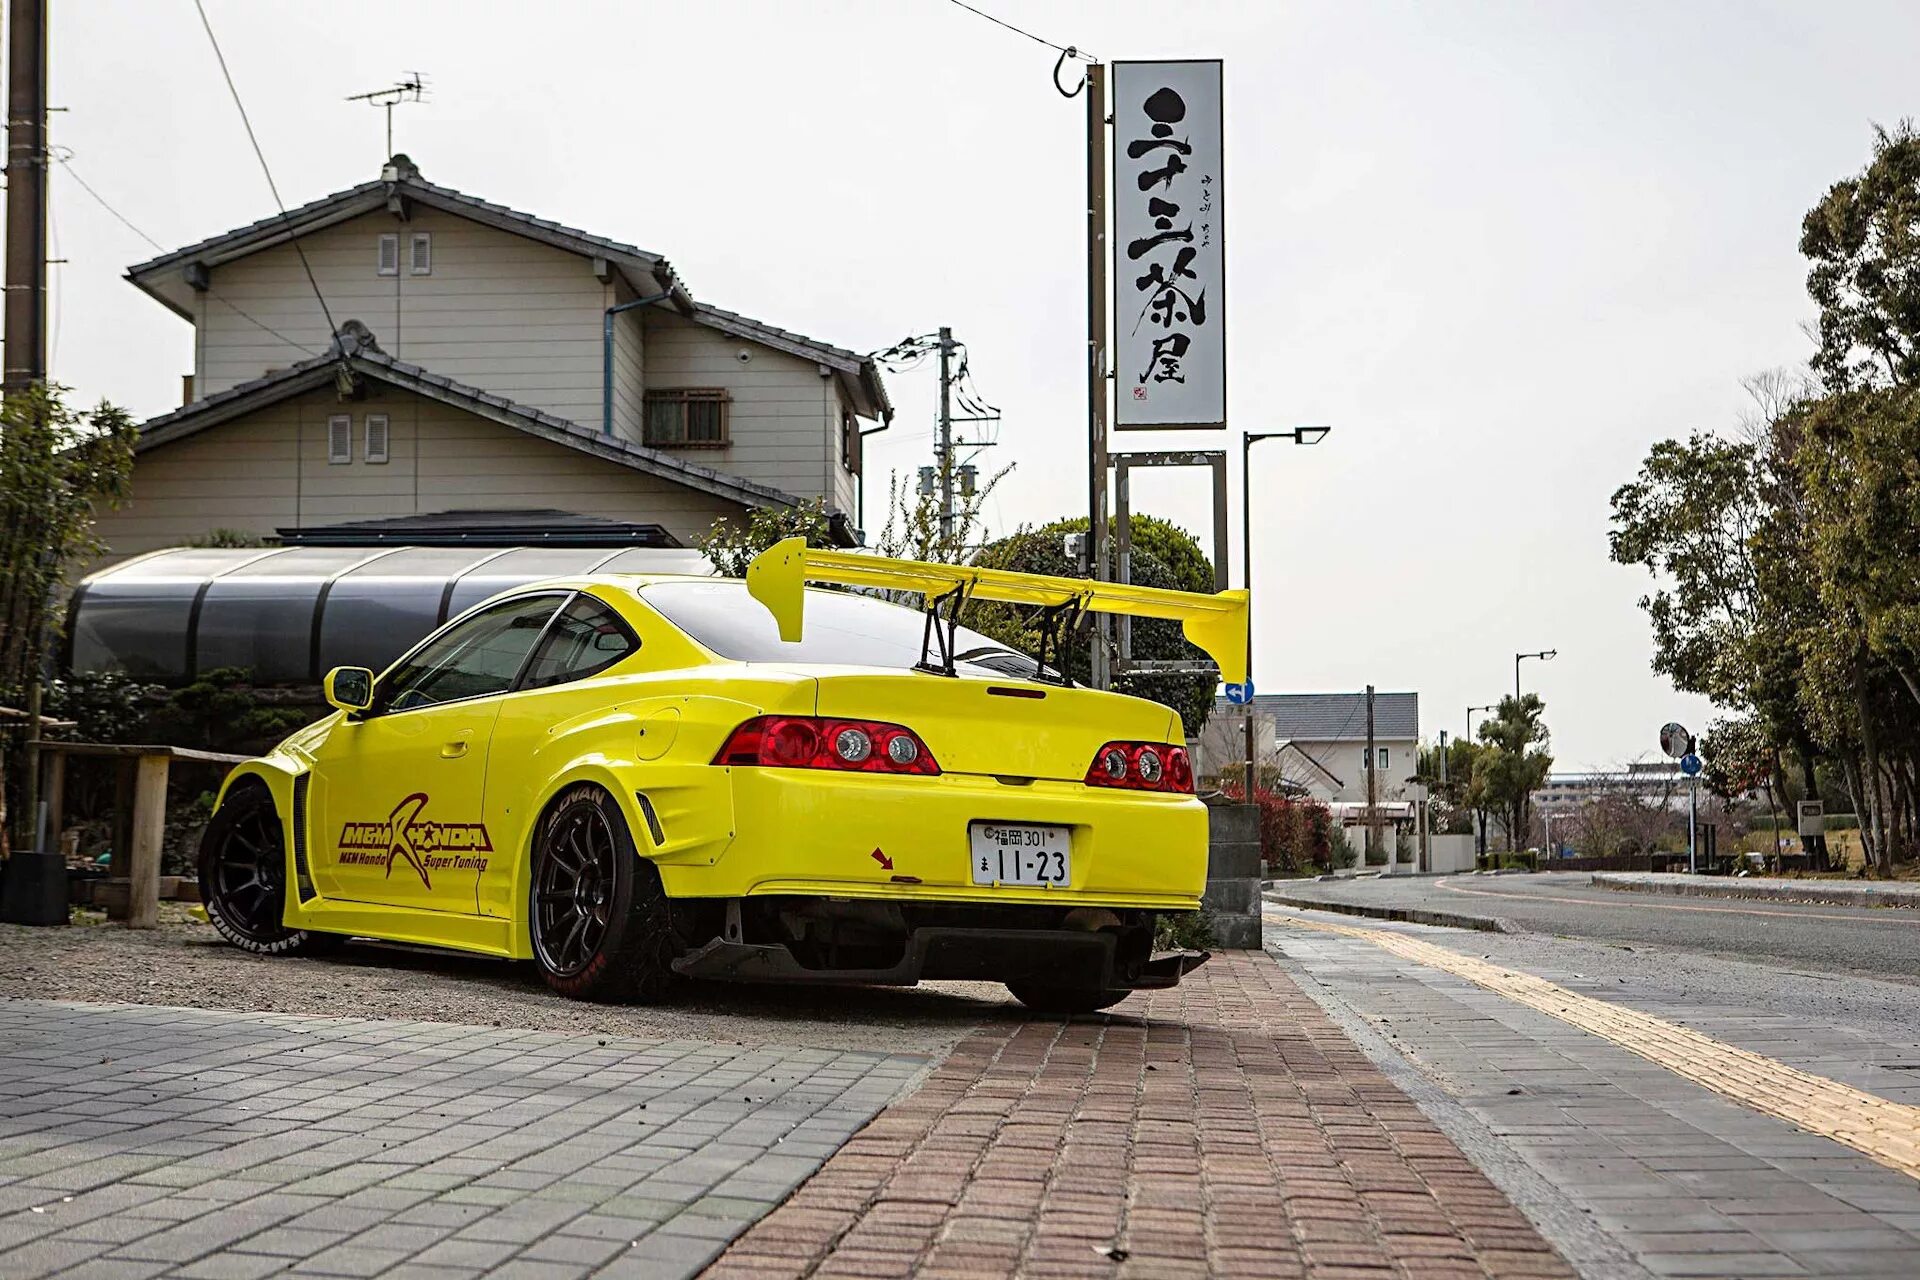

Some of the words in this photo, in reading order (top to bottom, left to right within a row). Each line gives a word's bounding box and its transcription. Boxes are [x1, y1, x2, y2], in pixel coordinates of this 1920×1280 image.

[1127, 87, 1206, 384] 三十三茶屋
[547, 786, 606, 830] ADVAN
[406, 821, 490, 852] HONDA
[1025, 830, 1046, 847] 301
[359, 853, 387, 866] Honda
[423, 854, 453, 871] Super
[453, 855, 489, 872] Tuning
[980, 856, 989, 872] ま
[998, 849, 1065, 881] 11-23
